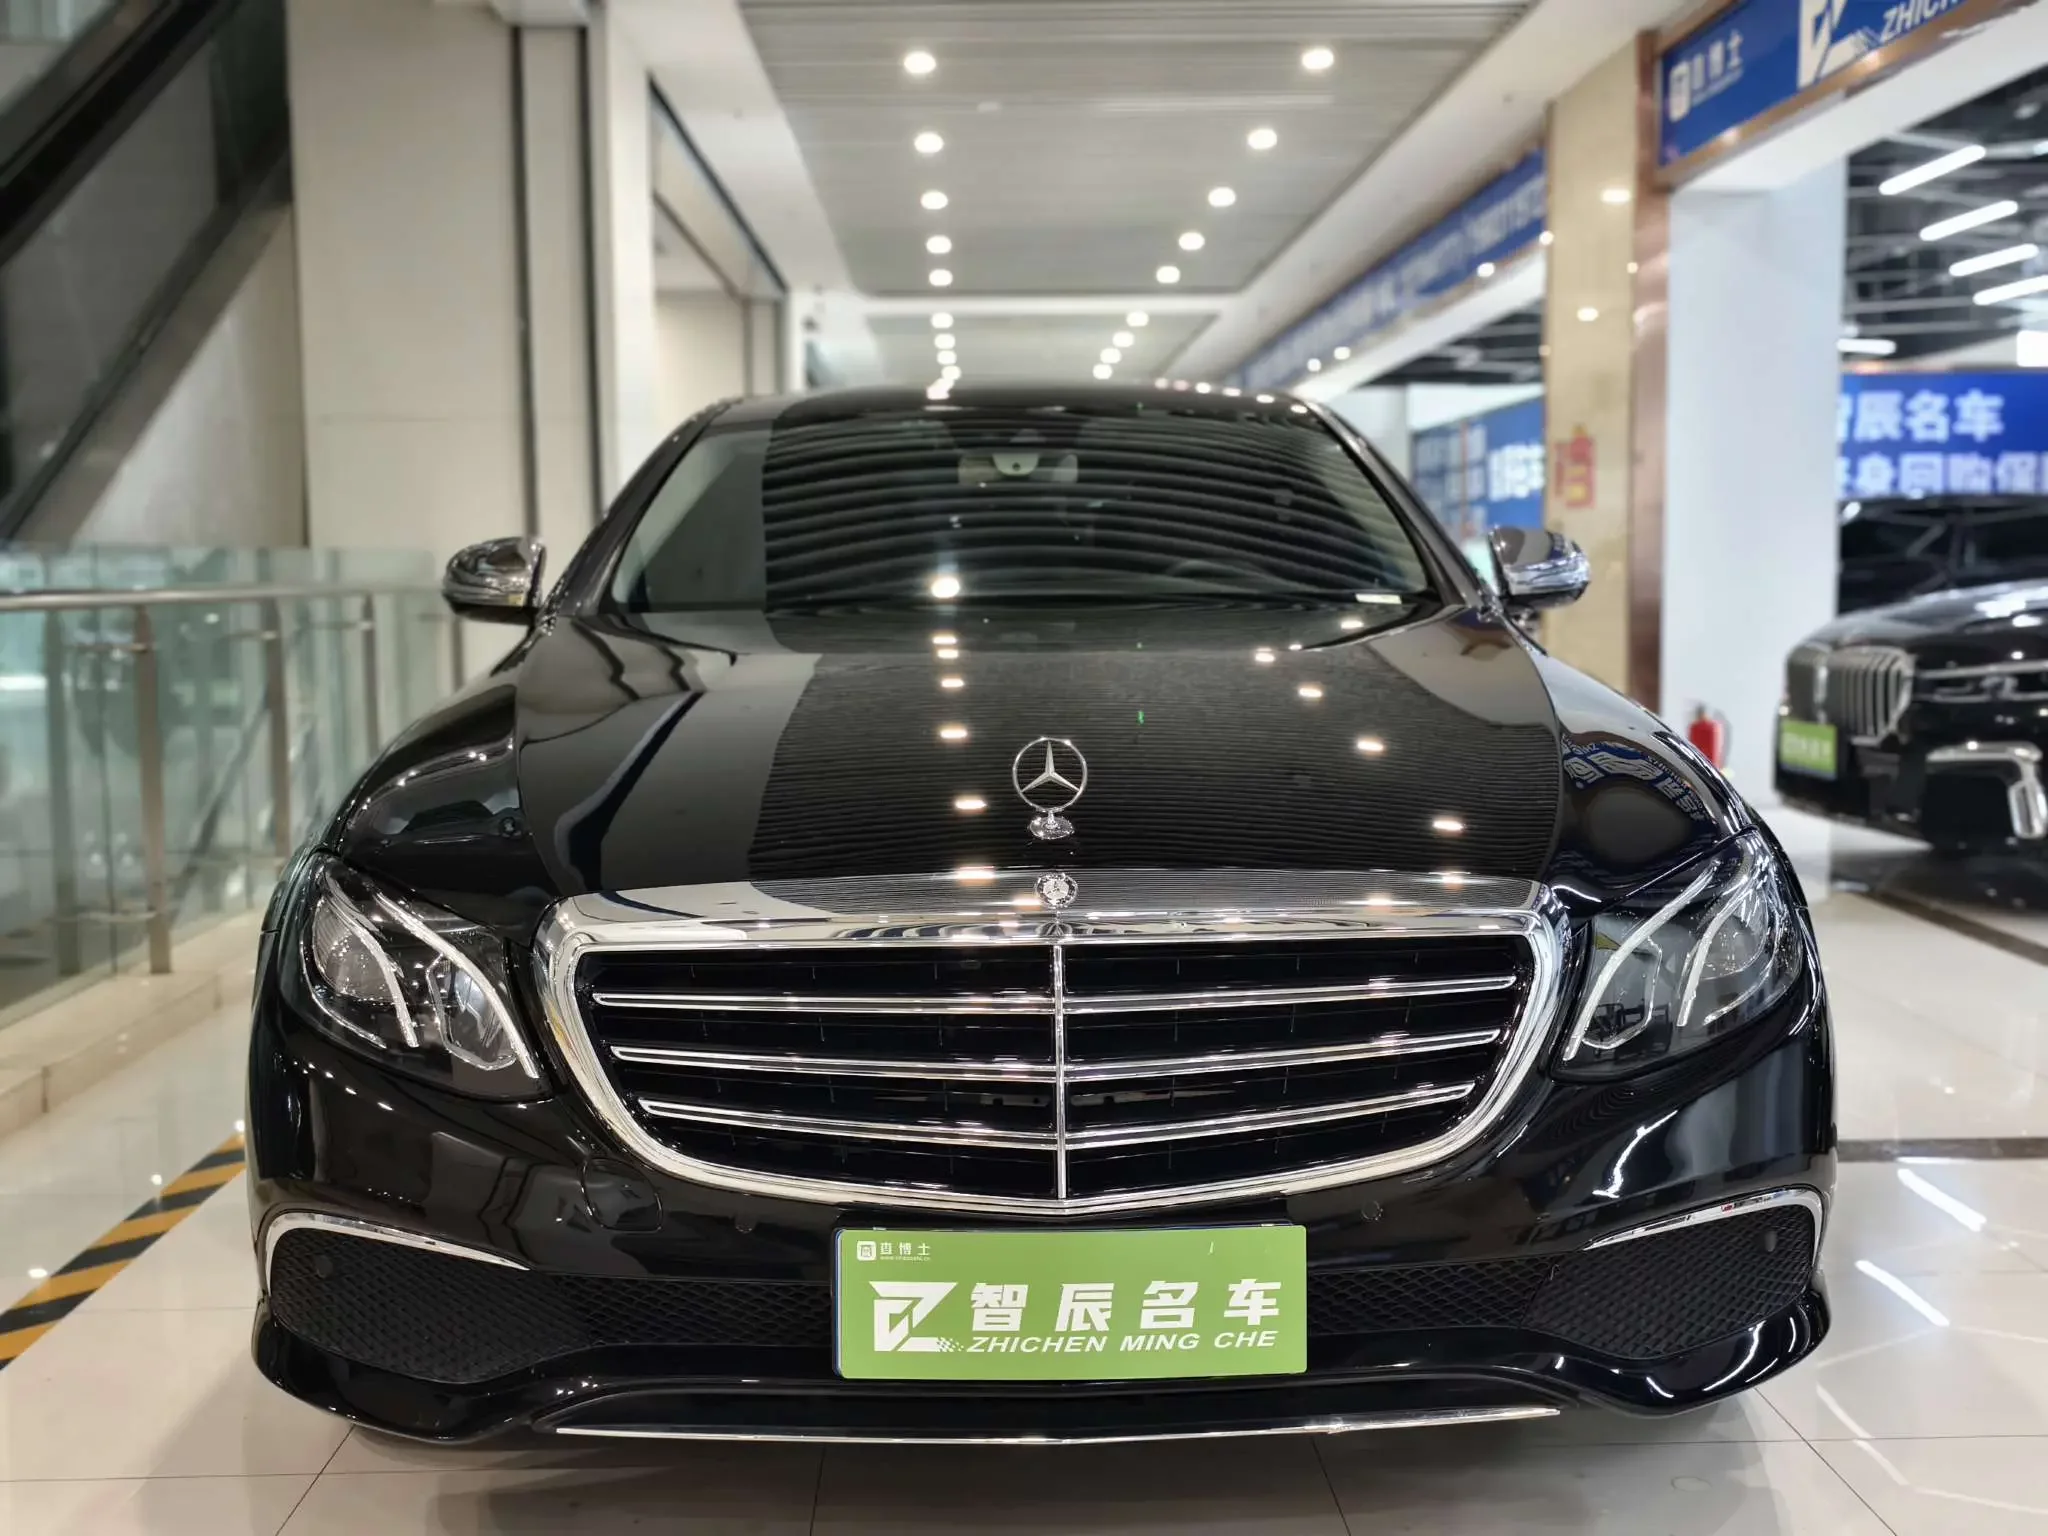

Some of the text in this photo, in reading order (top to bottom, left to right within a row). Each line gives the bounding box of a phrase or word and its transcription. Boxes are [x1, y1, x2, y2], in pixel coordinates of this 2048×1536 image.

[970, 1278, 1282, 1332] 智辰名车
[966, 1330, 1279, 1353] ZHICHEN MING CHE
